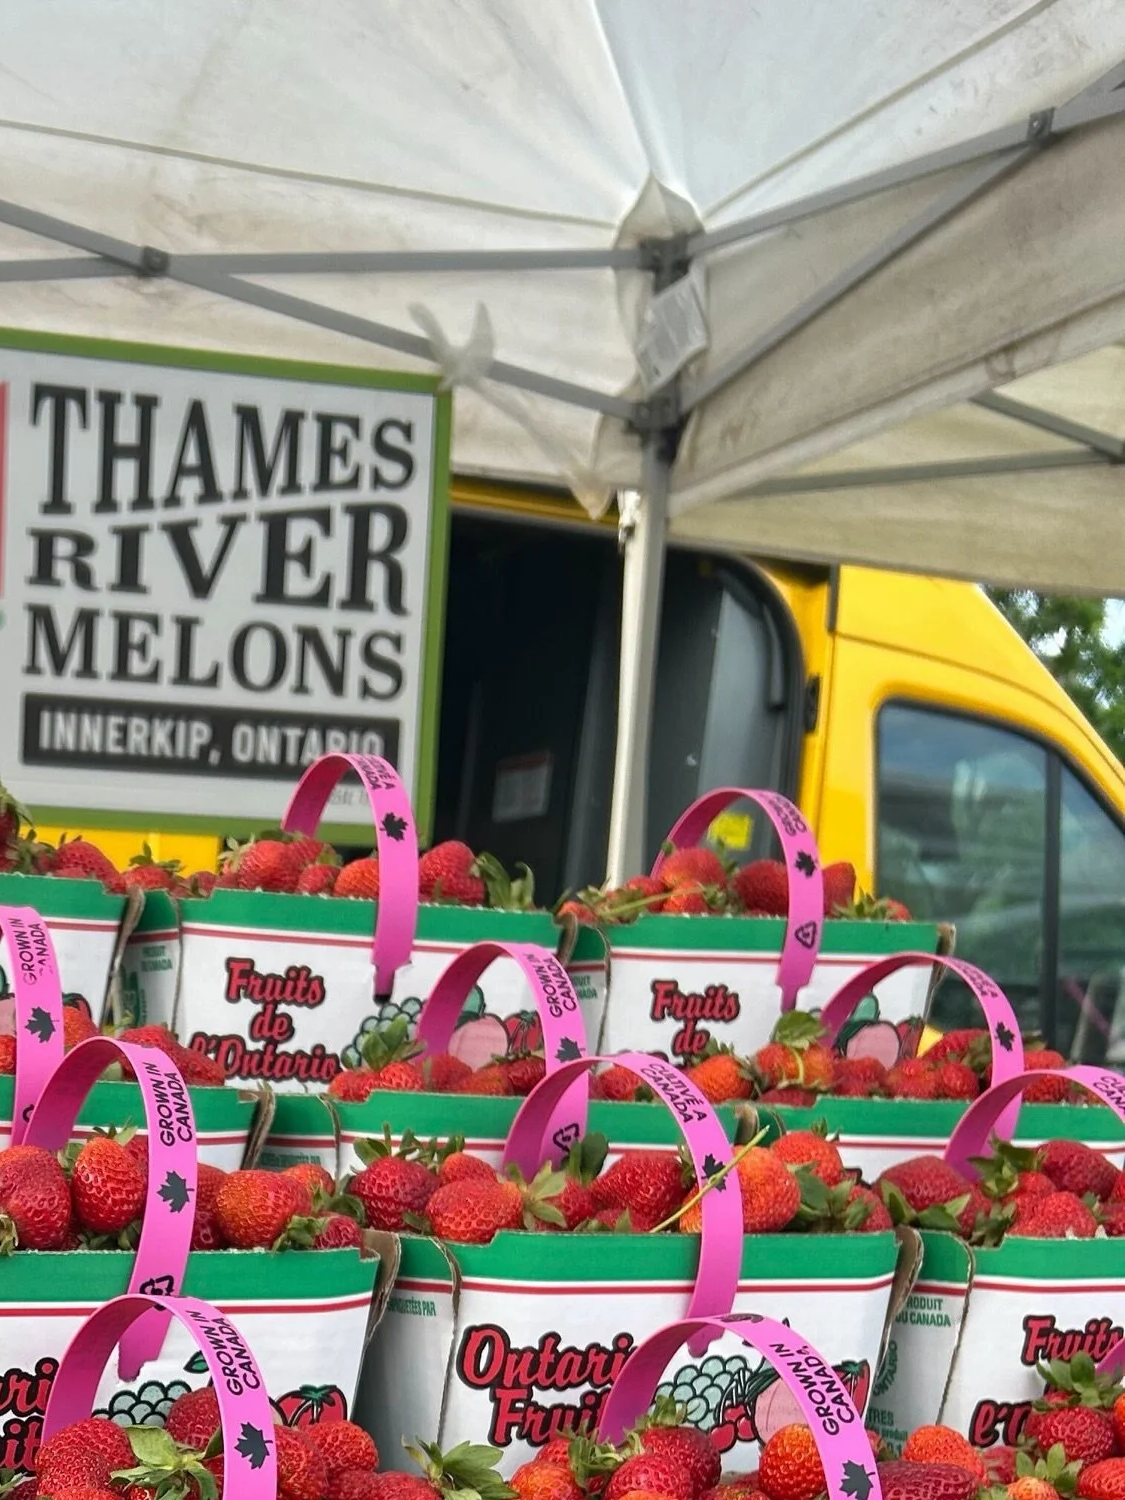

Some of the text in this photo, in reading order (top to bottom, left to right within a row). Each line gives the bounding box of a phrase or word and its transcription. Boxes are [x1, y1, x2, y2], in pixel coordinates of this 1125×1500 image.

[30, 381, 416, 515] THAMES
[25, 502, 411, 616] RIVER
[22, 602, 406, 701] MELONS
[39, 708, 221, 766] INNERKIP,
[18, 930, 38, 985] GROWN
[28, 922, 54, 977] ANADA
[225, 957, 326, 1009] Fruits
[533, 965, 563, 1018] GROWN
[543, 958, 577, 1012] CANADA
[650, 979, 741, 1022] Fruits
[250, 1002, 295, 1043] de
[671, 1019, 711, 1057] de
[142, 1062, 175, 1147] GROWN IN
[166, 1072, 193, 1142] CANADA
[640, 1068, 694, 1123] CANADA
[648, 1063, 704, 1106] CULTIVÉ
[906, 1296, 944, 1311] RODUIT
[909, 1312, 952, 1327] CANADA
[185, 1310, 244, 1396] GROWN IN
[211, 1317, 261, 1390] CANADA
[456, 1323, 638, 1391] Ontari
[768, 1343, 840, 1435] GROWN IN
[488, 1388, 611, 1447] Frui
